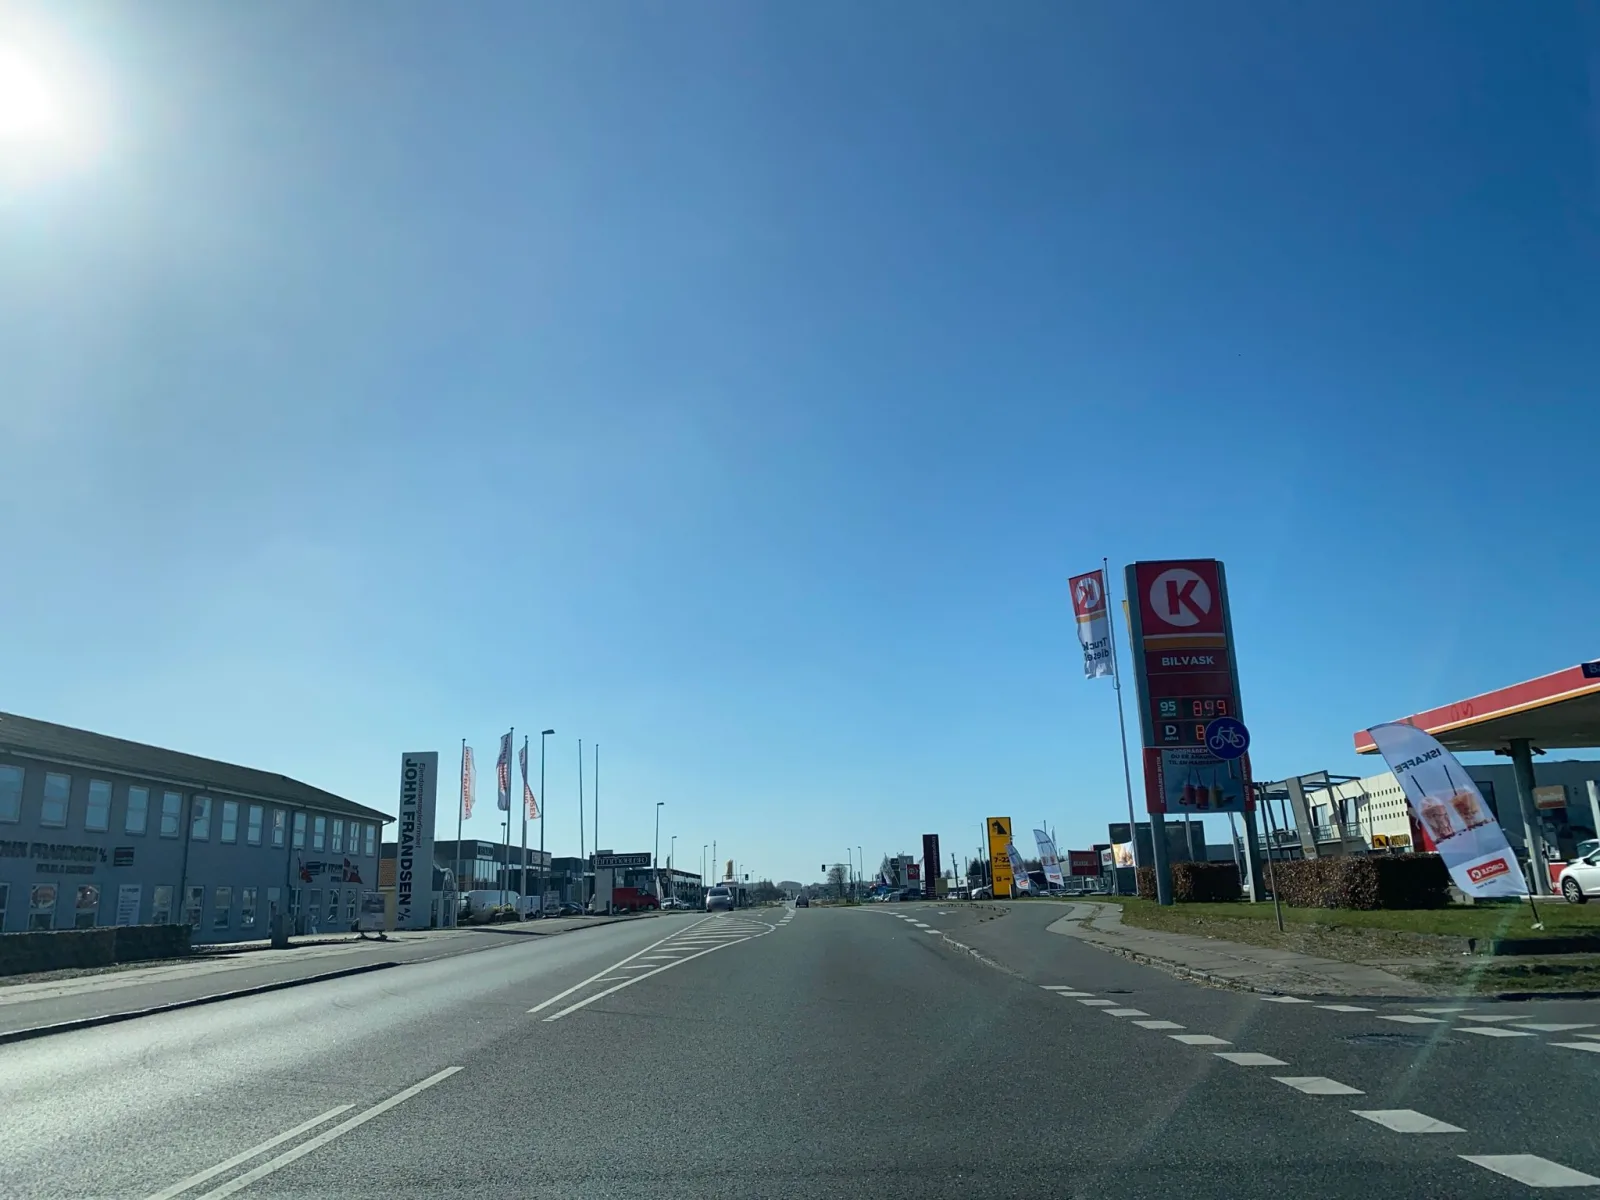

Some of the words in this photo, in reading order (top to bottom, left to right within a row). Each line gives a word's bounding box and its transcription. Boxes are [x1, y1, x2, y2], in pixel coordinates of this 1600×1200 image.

[1166, 580, 1207, 621] K
[1162, 655, 1214, 667] BILVASK
[1160, 701, 1176, 712] 95
[1165, 725, 1177, 736] D
[403, 758, 418, 806] JOHN
[398, 811, 416, 906] FRANDSEN
[397, 907, 411, 922] A/S
